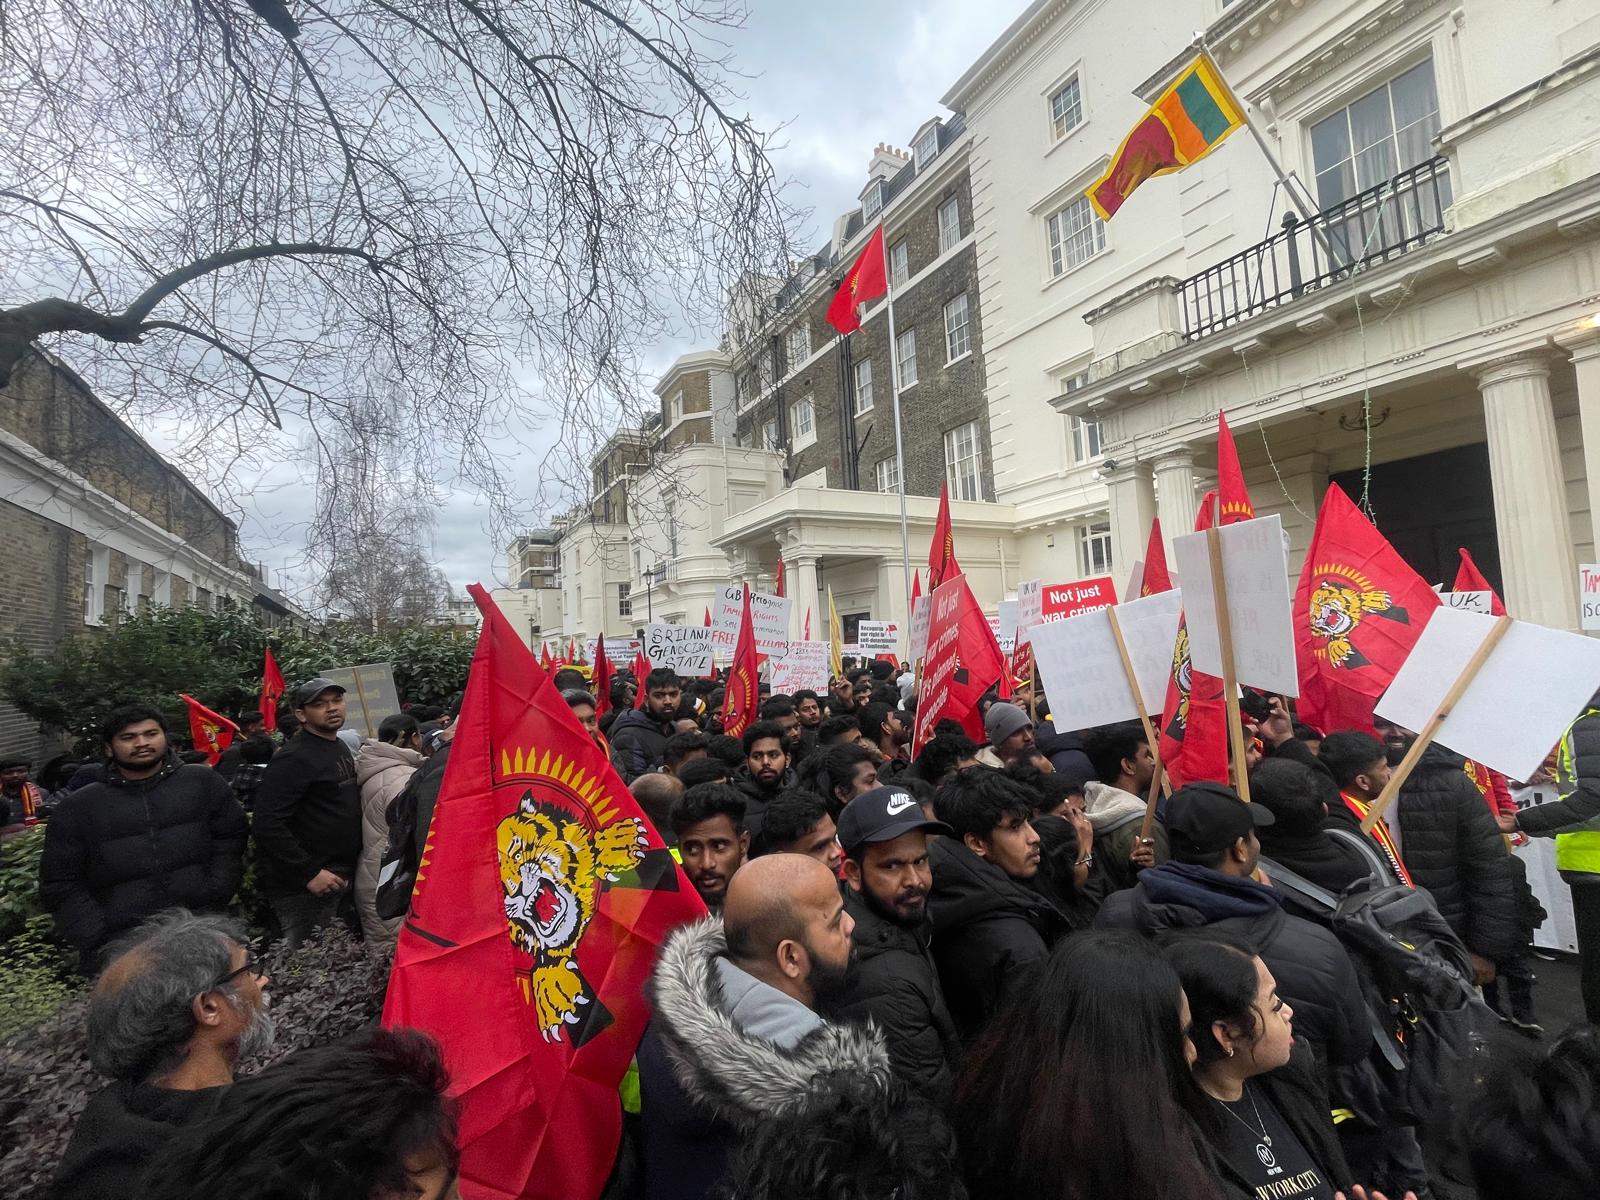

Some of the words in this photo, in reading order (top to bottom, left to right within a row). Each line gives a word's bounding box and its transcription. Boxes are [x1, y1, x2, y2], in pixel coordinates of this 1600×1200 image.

[725, 588, 741, 600] GB
[1050, 589, 1074, 604] Not
[1076, 584, 1101, 602] just
[1450, 593, 1481, 607] UK
[723, 604, 743, 617] TAMI
[753, 610, 778, 621] RIGHTS
[936, 595, 947, 623] Not
[946, 587, 959, 619] just
[1041, 610, 1066, 624] war
[711, 630, 736, 645] FREE
[926, 637, 938, 667] war
[938, 622, 959, 648] crimes
[664, 655, 708, 670] STATE
[931, 647, 957, 697] planned
[920, 685, 949, 740] genocide
[890, 793, 910, 806] NIKE
[1267, 1177, 1302, 1199] YORK
[1296, 1169, 1320, 1190] CITY
